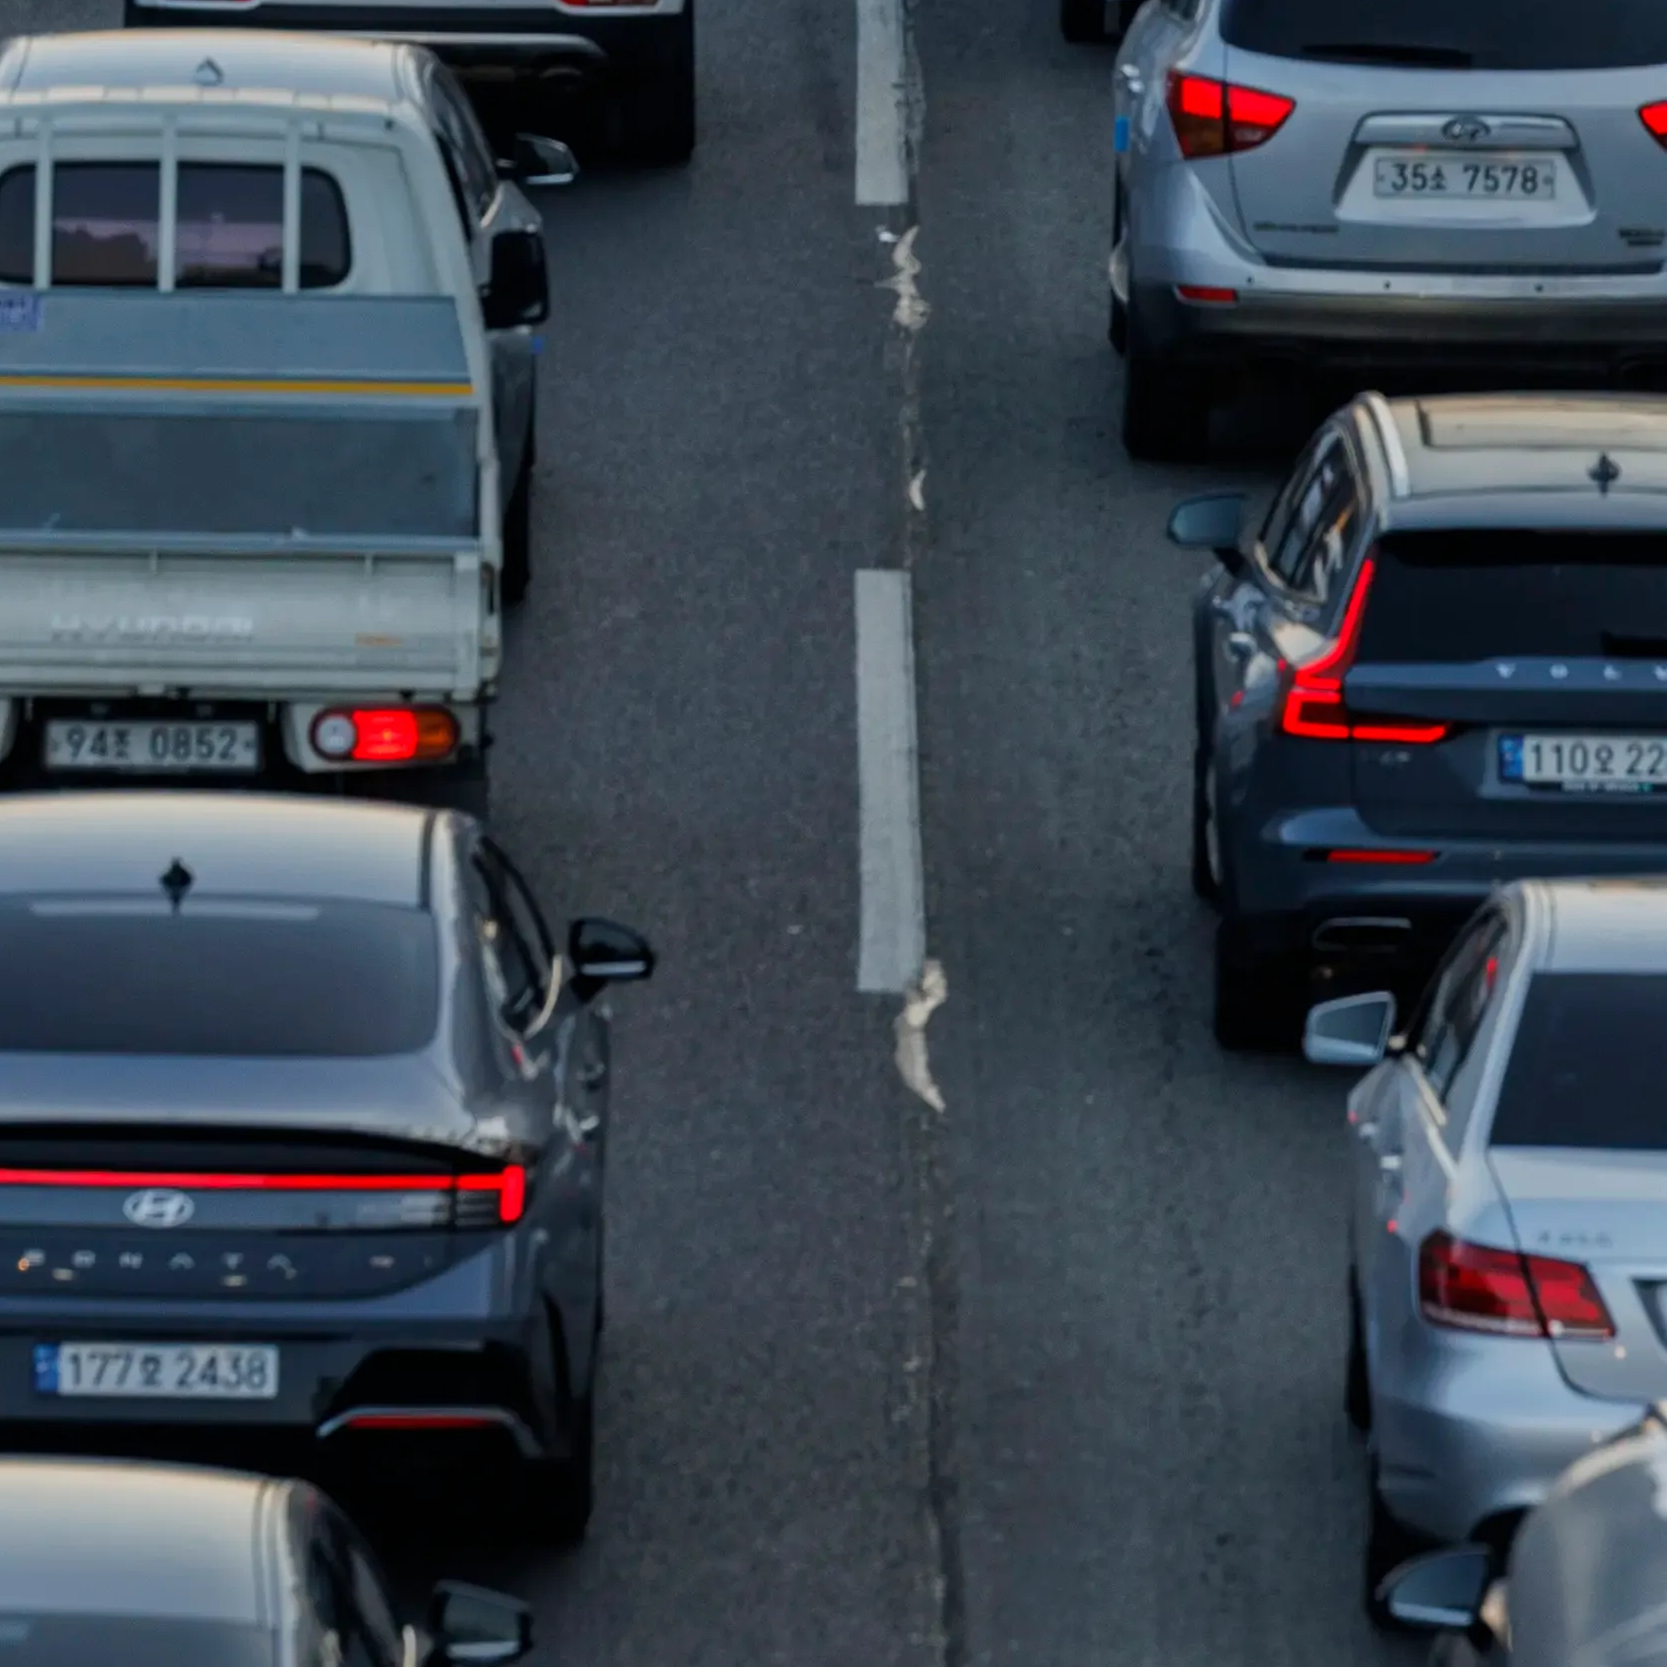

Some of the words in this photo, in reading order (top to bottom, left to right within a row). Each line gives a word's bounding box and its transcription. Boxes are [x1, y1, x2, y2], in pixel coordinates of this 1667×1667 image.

[1462, 164, 1539, 195] 7578
[147, 726, 238, 762] 0852
[175, 1353, 268, 1390] 2438
